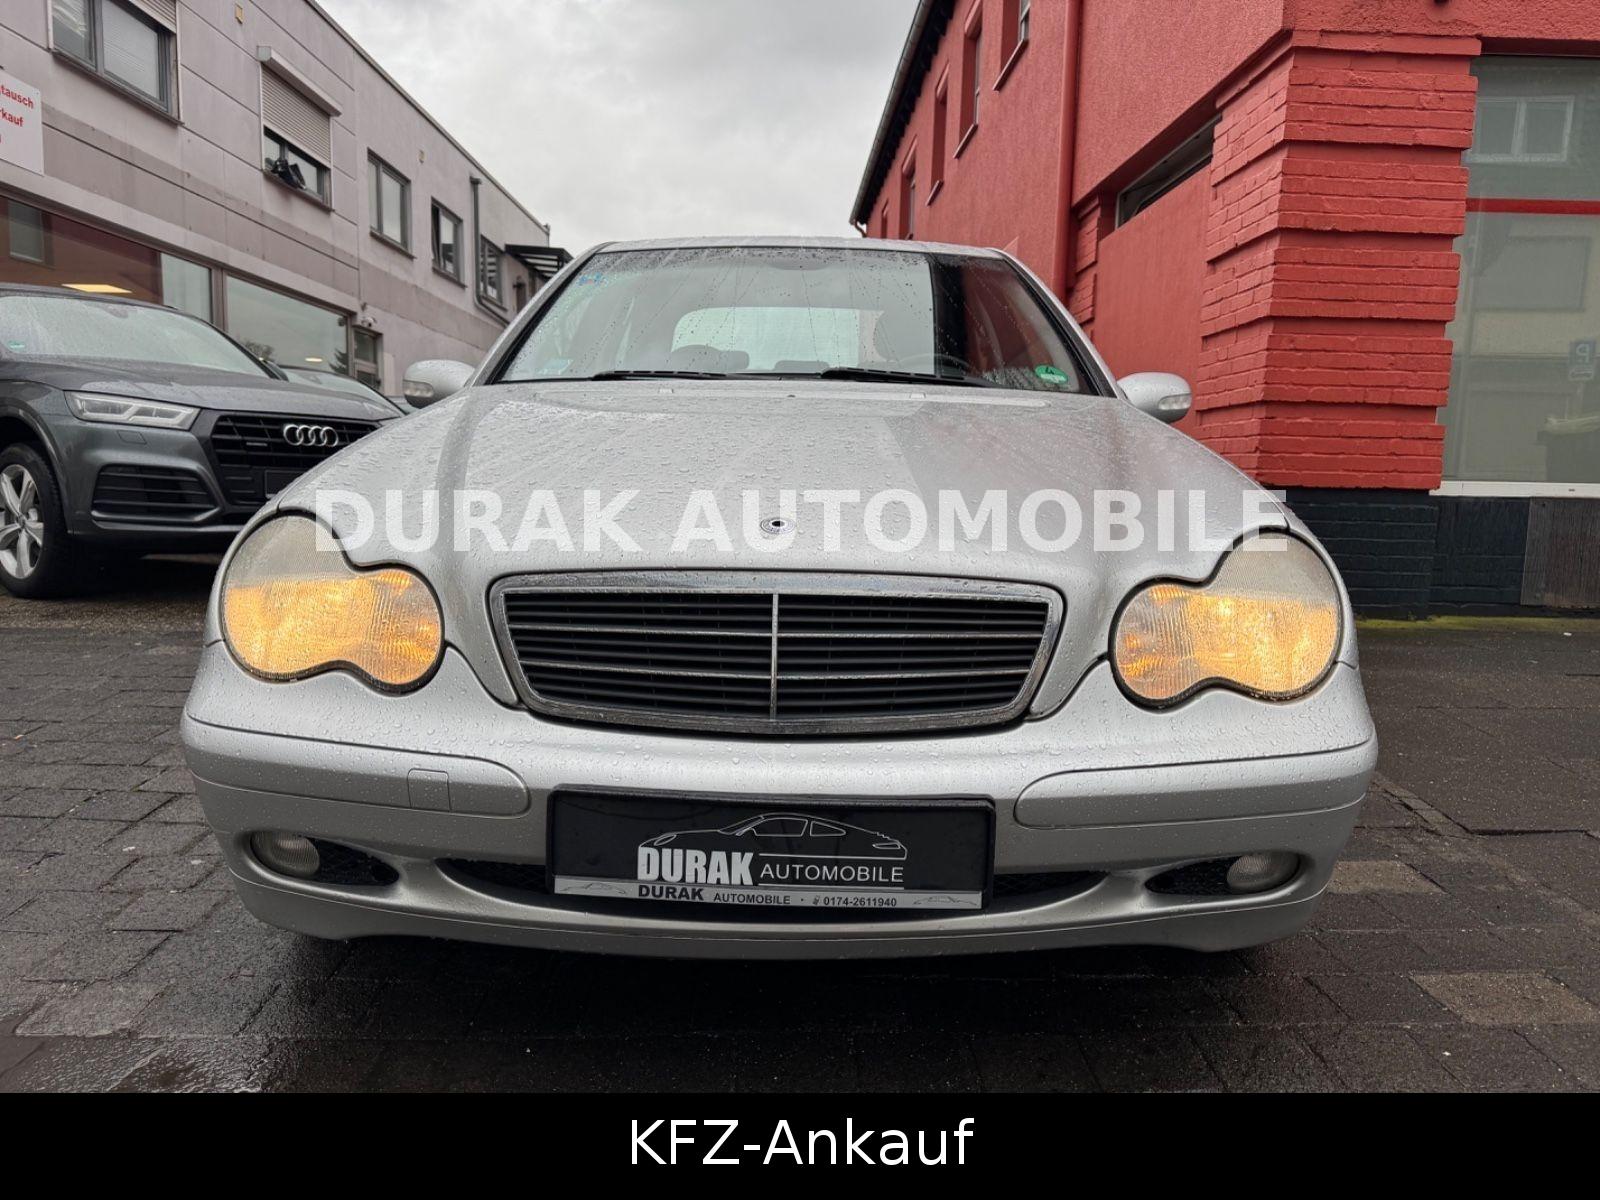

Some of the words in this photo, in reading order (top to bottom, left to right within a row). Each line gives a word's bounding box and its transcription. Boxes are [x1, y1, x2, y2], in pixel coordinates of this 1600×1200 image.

[0, 84, 34, 109] tausch
[637, 846, 754, 886] DURAK
[760, 863, 904, 883] AUTOMOBILE
[638, 884, 704, 901] DURAK
[713, 892, 791, 905] AUTOMOBILE
[823, 895, 897, 907] 0174-2611940
